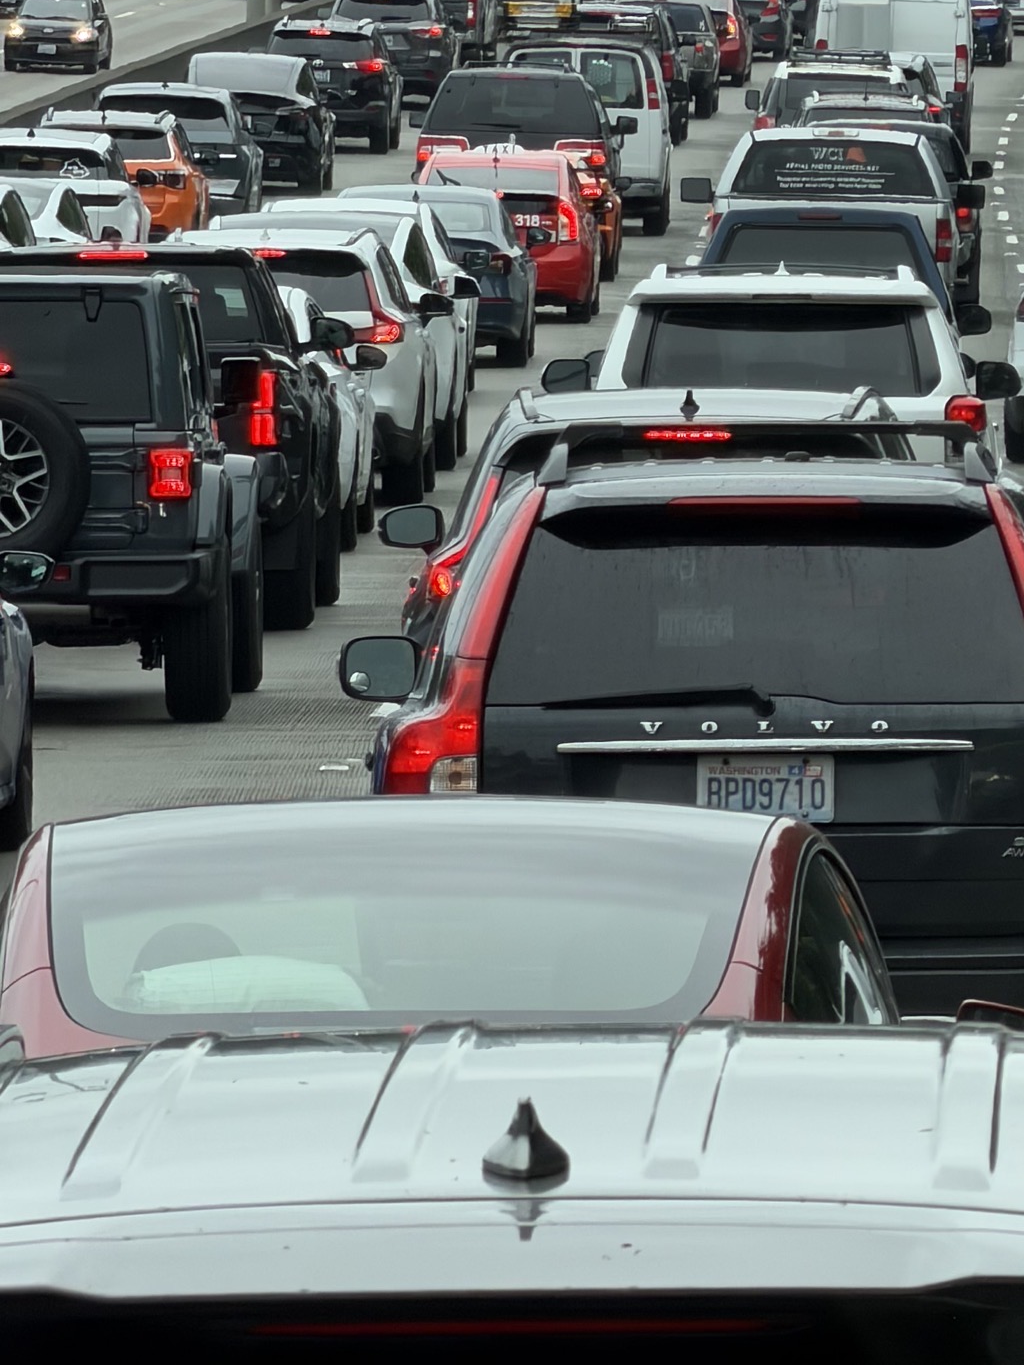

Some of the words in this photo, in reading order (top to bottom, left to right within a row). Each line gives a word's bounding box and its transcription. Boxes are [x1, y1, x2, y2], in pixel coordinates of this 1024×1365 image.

[483, 145, 516, 154] TAXI
[809, 147, 844, 161] WCI
[514, 214, 540, 226] 318
[639, 720, 889, 734] VOLVO
[708, 766, 781, 776] WASHINGTON
